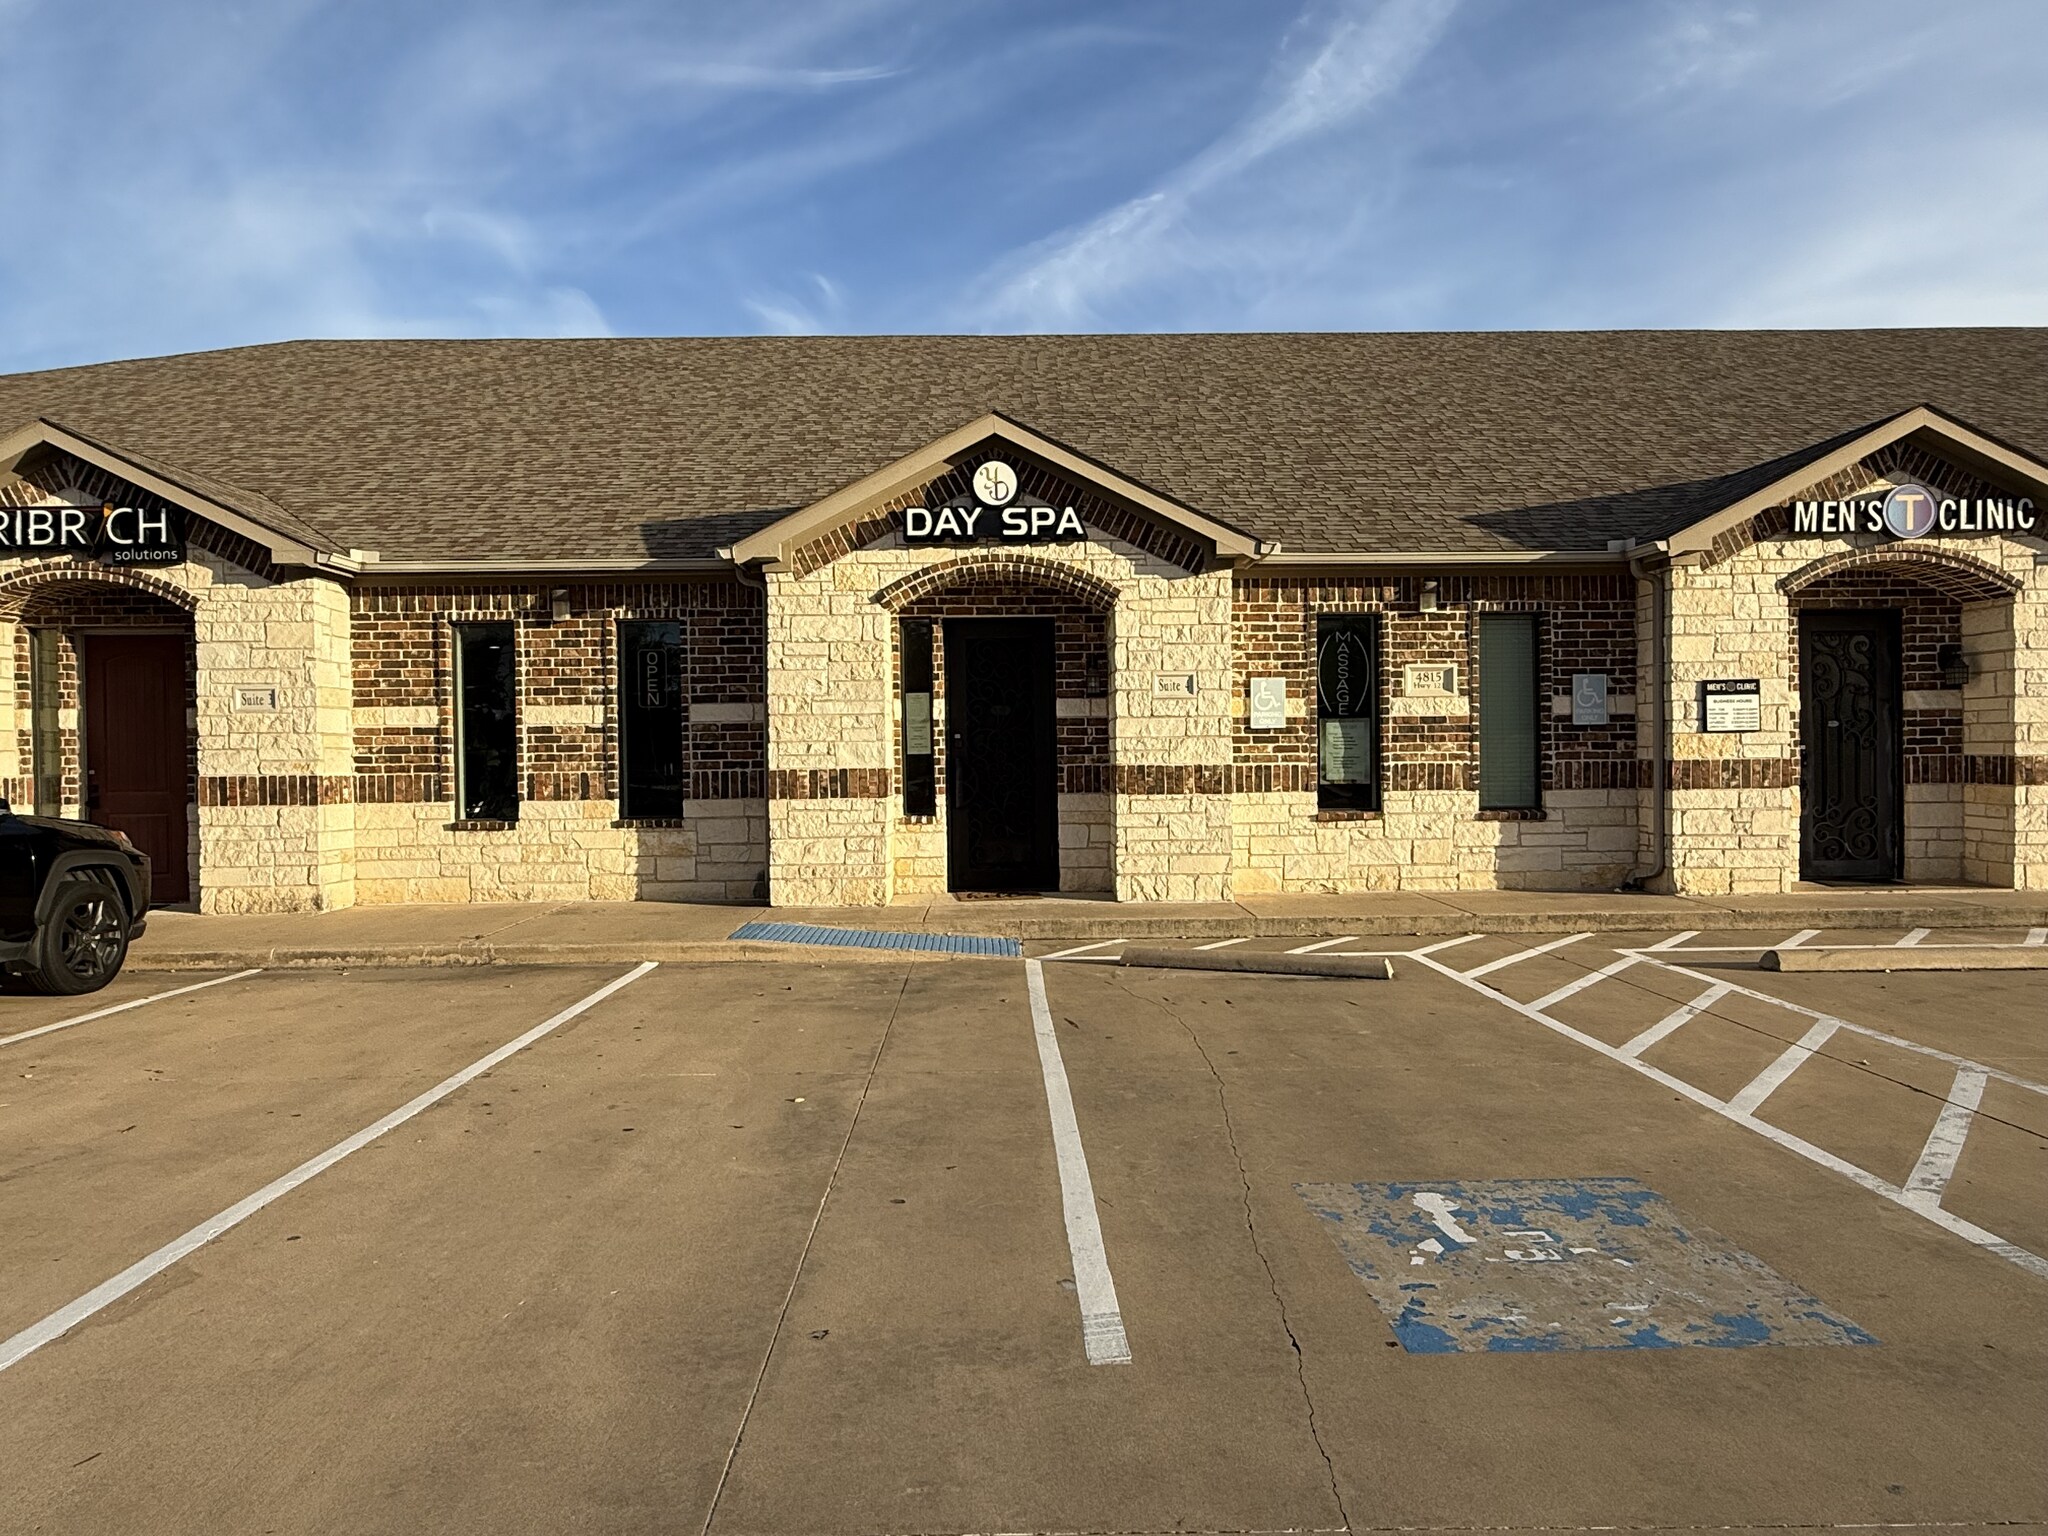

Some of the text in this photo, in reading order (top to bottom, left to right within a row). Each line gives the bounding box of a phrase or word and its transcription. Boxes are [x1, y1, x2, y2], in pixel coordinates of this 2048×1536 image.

[906, 506, 1084, 536] DAY SPA
[1794, 494, 2035, 532] MEN'S T CLINIC
[115, 547, 178, 561] solutions
[646, 651, 660, 706] OPEN
[1335, 631, 1351, 716] MASSAGE
[1415, 672, 1442, 682] 4815
[1158, 678, 1181, 692] Suite
[241, 692, 265, 706] Suite
